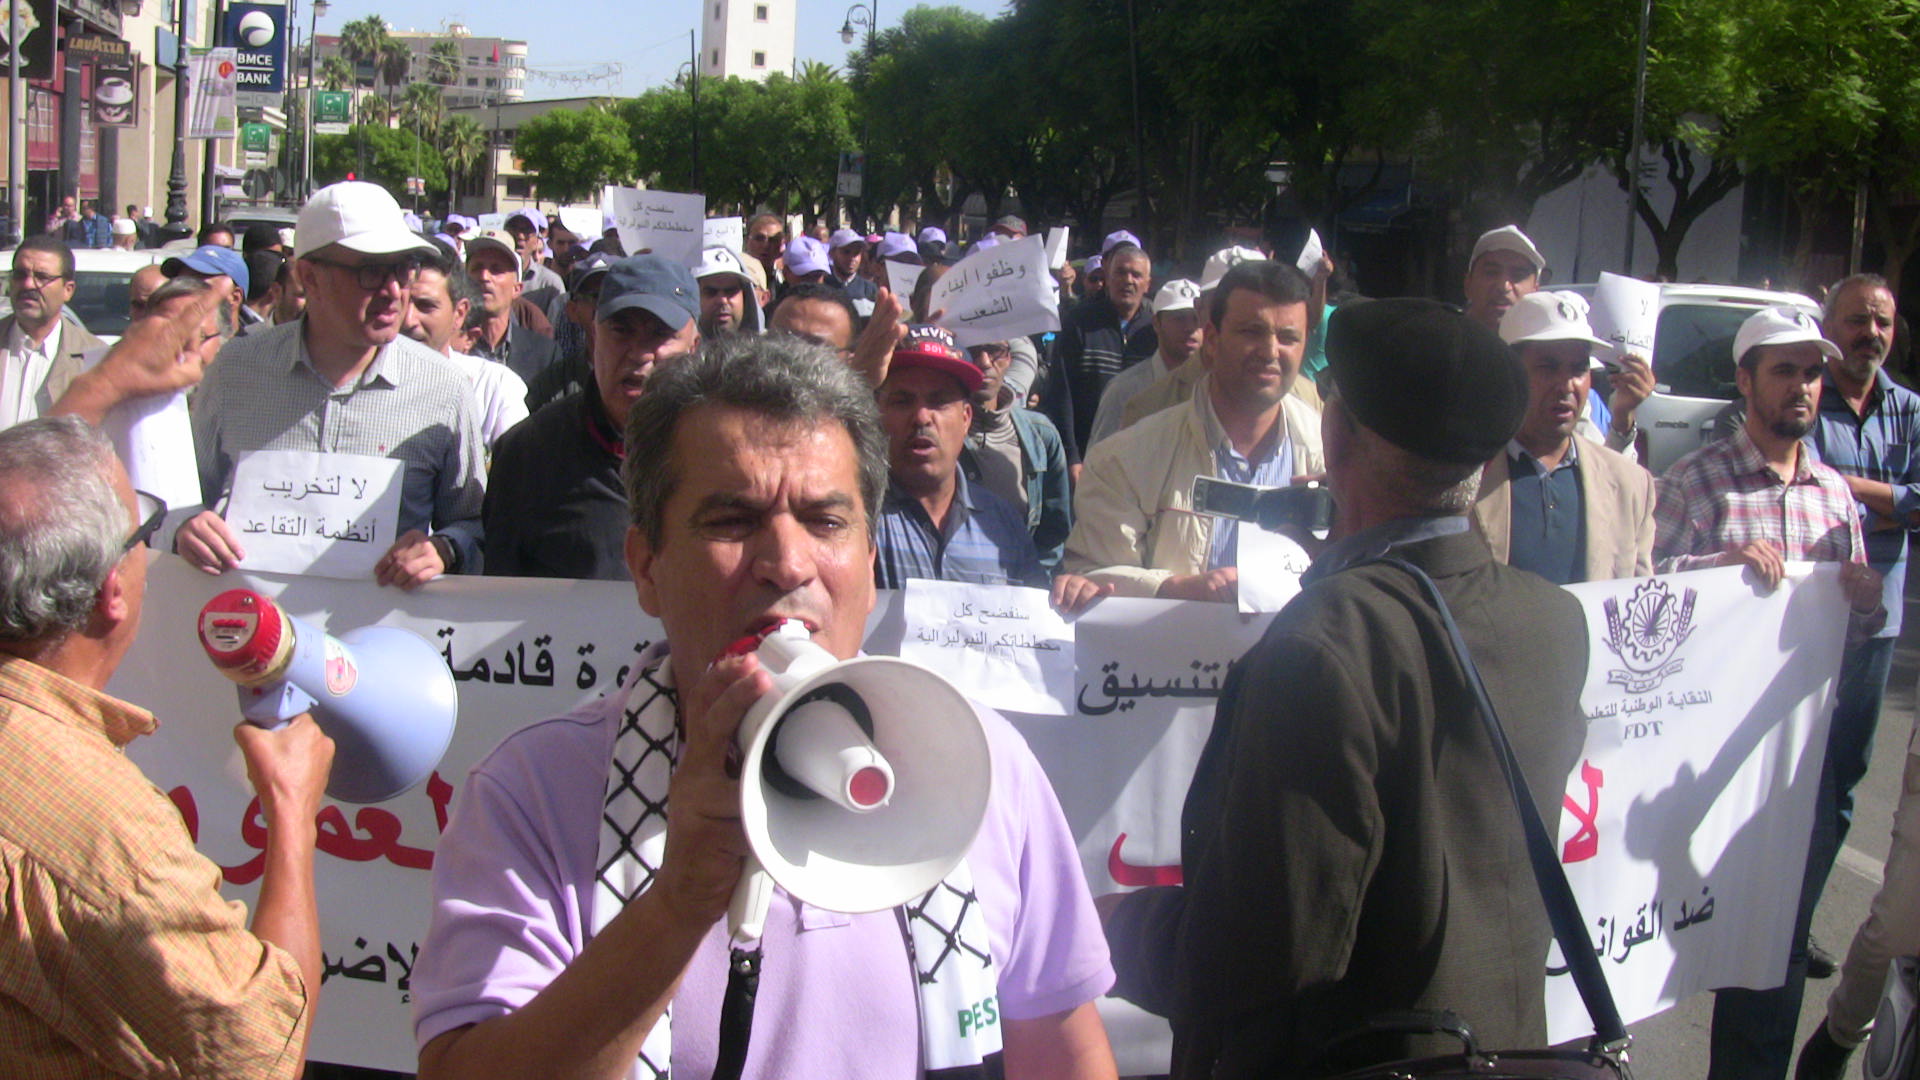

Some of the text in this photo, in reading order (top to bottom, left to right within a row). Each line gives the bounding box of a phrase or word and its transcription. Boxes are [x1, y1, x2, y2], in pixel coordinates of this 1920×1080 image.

[237, 53, 272, 65] BMCE
[237, 72, 271, 85] BANK
[976, 259, 1026, 287] وظفوا
[960, 296, 1013, 325] الشعب
[910, 327, 954, 346] LEVI'S
[924, 343, 942, 354] 501
[263, 475, 367, 501] لا لتخريب
[243, 515, 307, 537] التقاعد
[953, 602, 1030, 624] سنفضح كل
[992, 633, 1061, 651] مخططاتكم
[1621, 695, 1662, 717] الوطنية
[1667, 690, 1712, 710] النقابة
[1624, 720, 1663, 739] FDT
[1674, 886, 1715, 931] ضد
[957, 996, 999, 1038] PES
